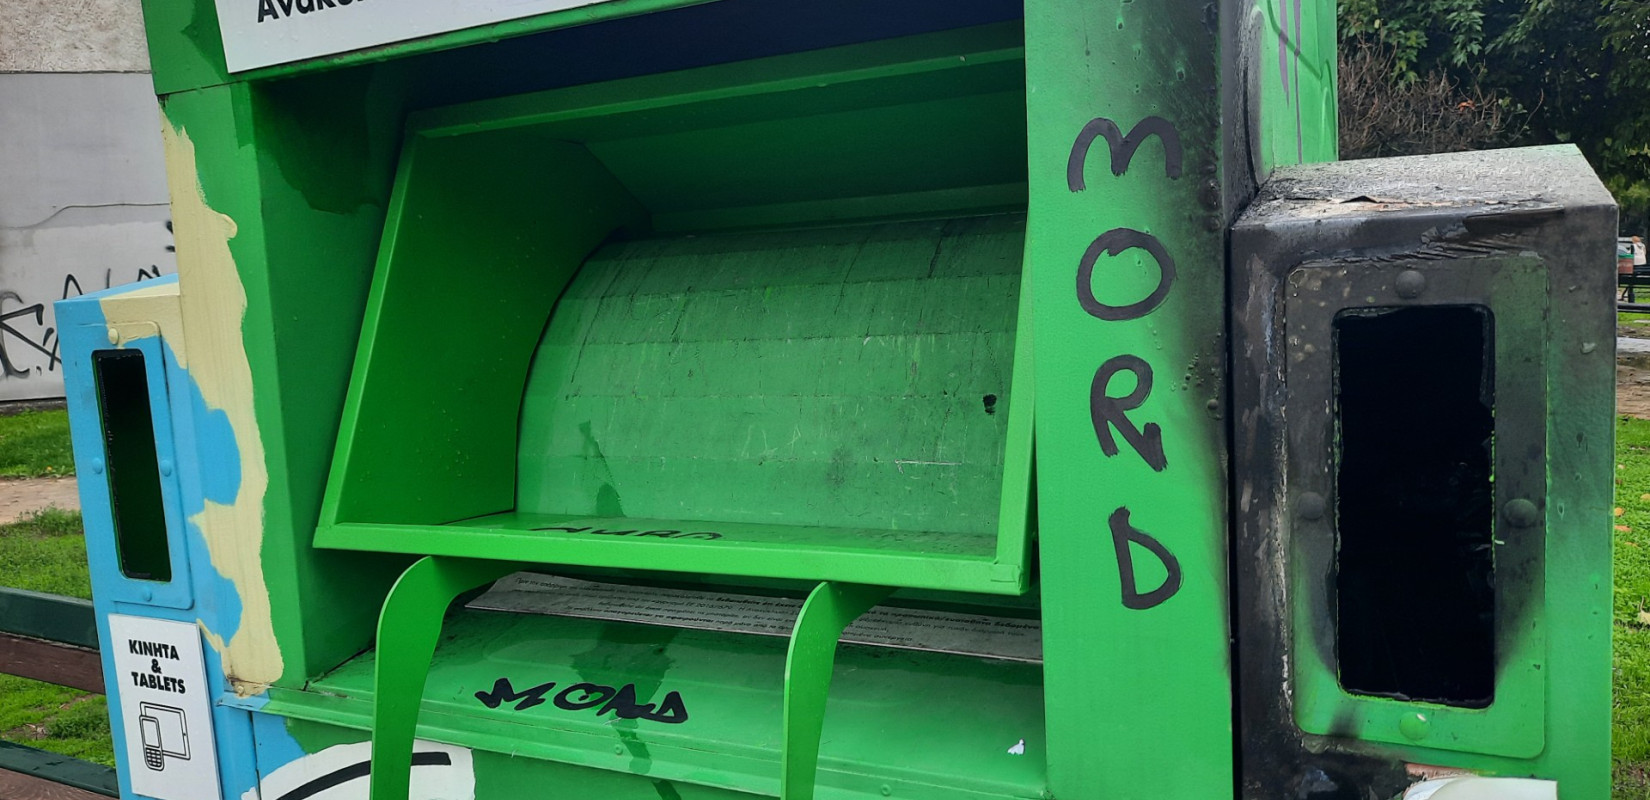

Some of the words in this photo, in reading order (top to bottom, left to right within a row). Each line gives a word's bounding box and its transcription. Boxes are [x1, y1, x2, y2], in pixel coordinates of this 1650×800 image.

[1067, 117, 1183, 610] MORD
[994, 620, 1039, 631] δεδομένα
[128, 639, 180, 660] ΚΙΝΗΤΑ
[151, 658, 162, 674] &
[131, 671, 186, 694] TABLETS
